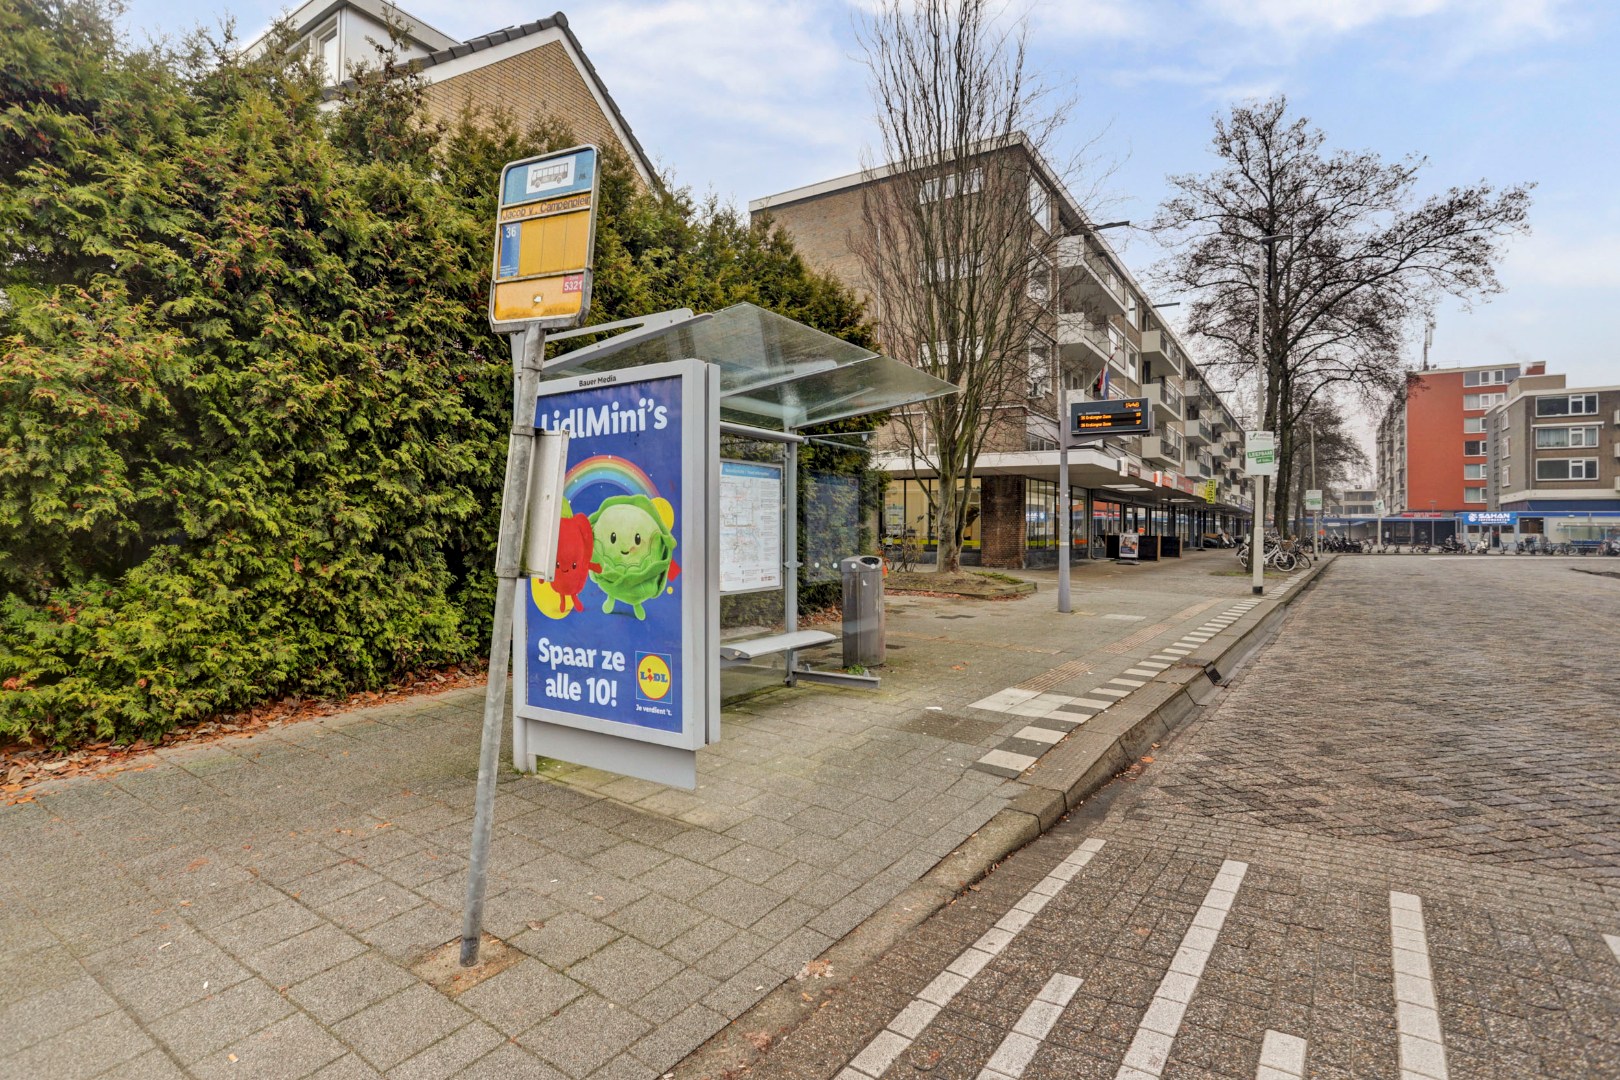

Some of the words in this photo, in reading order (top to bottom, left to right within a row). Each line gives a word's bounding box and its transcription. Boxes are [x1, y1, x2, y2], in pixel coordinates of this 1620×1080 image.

[502, 208, 526, 220] Jacob
[506, 226, 517, 239] 36
[563, 280, 583, 291] 5321
[578, 378, 596, 387] Bauer
[597, 375, 617, 384] Media
[538, 637, 597, 670] Spaar
[601, 650, 626, 672] ze
[545, 672, 582, 702] alle
[586, 677, 617, 707] 10!
[635, 704, 643, 712] Je
[643, 706, 666, 715] verdient
